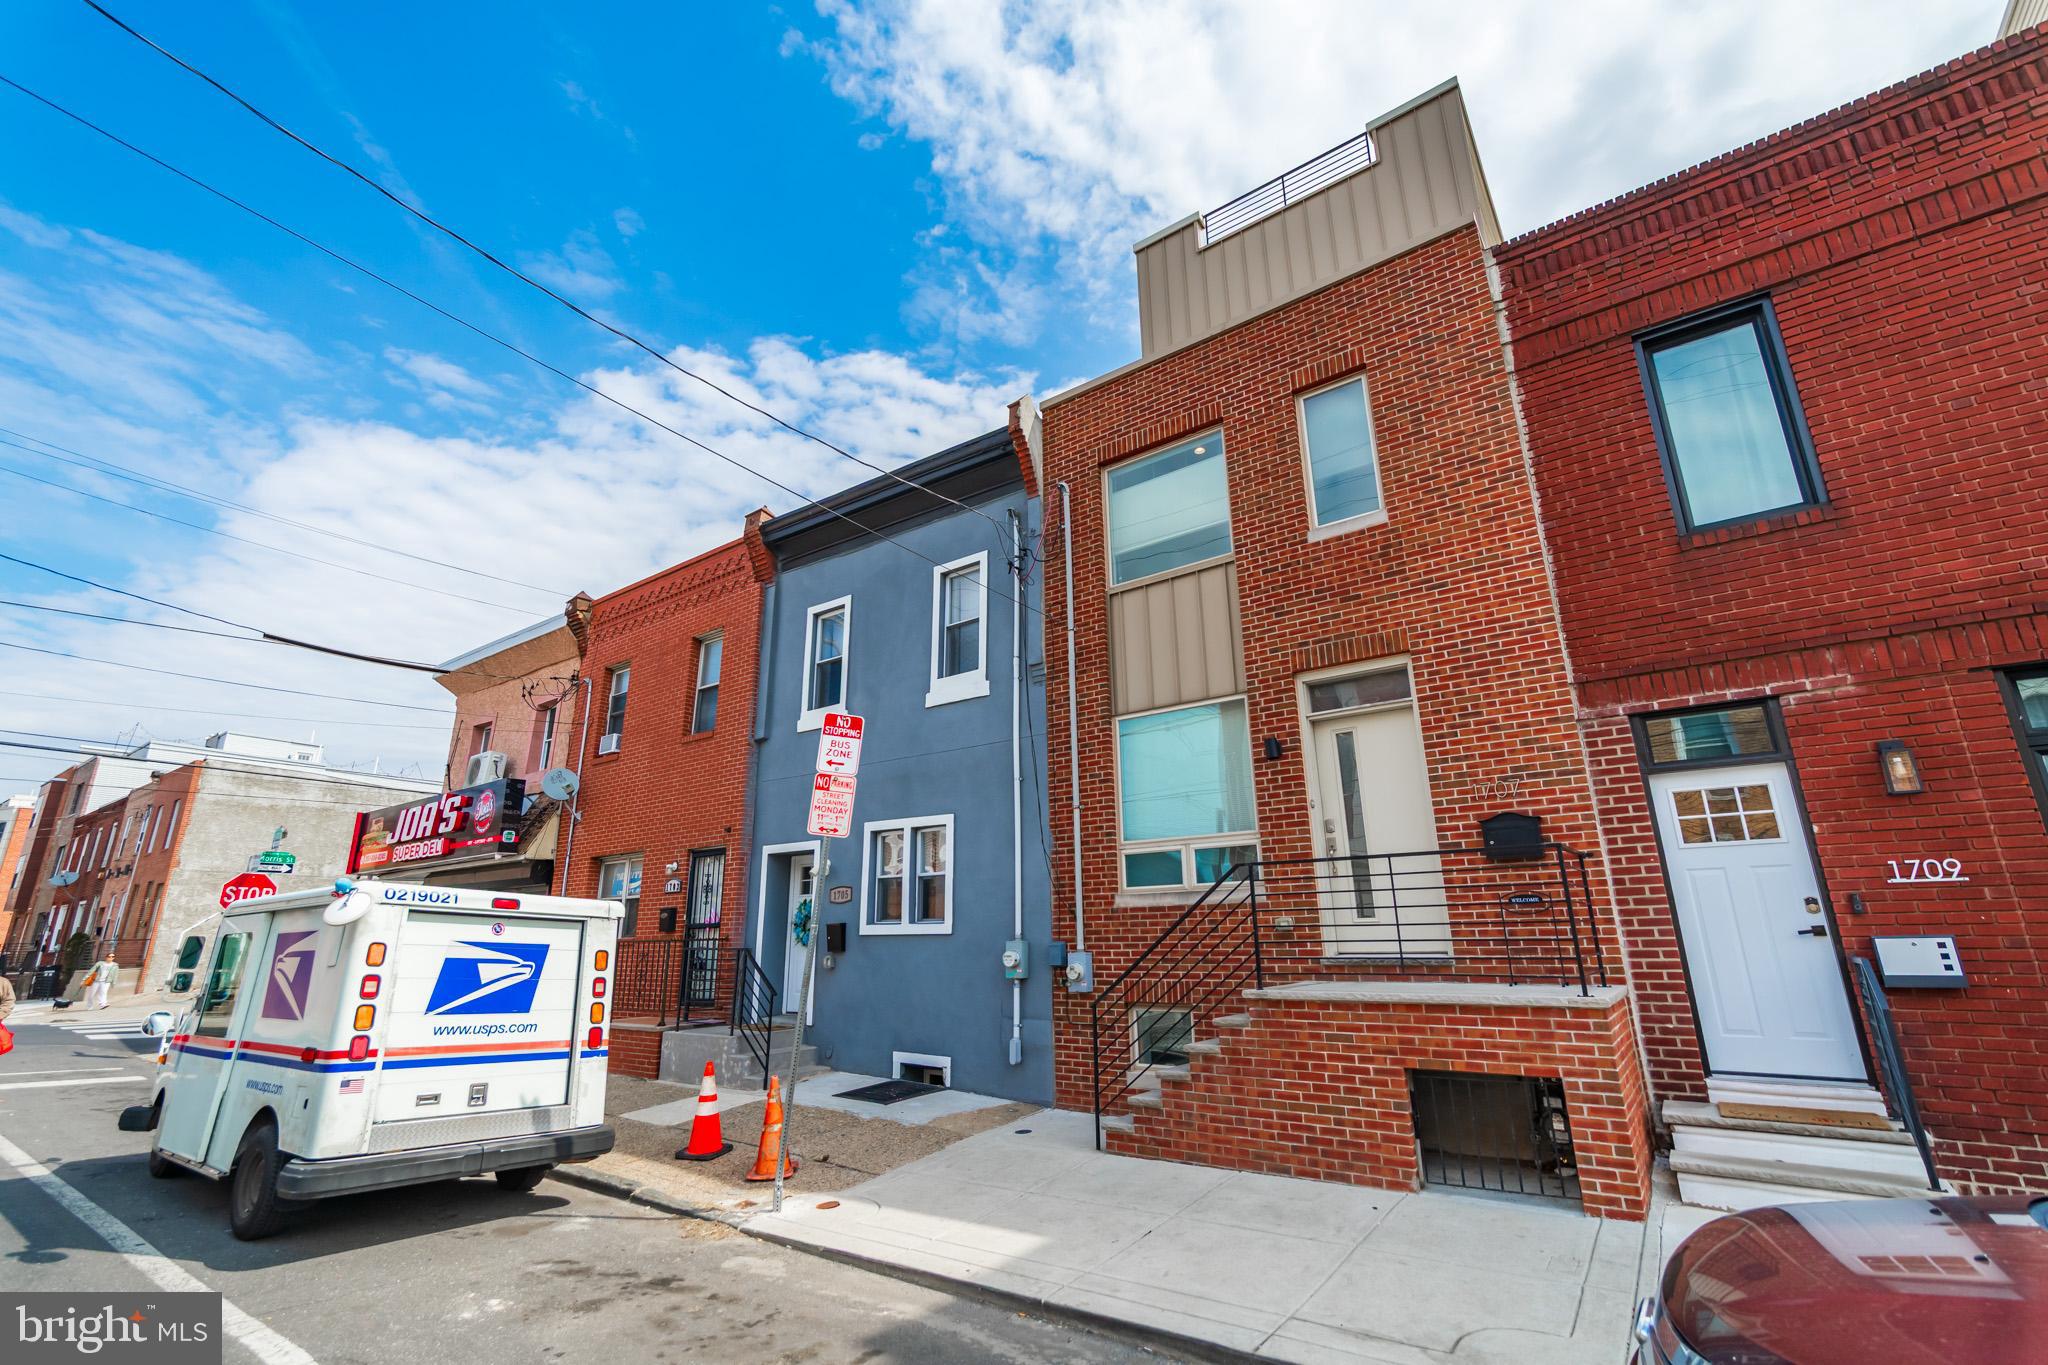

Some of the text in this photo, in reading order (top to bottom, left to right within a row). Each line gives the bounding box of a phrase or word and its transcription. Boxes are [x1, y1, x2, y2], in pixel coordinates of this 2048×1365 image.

[836, 716, 851, 728] NO
[825, 726, 861, 738] STOPPING
[830, 739, 851, 749] BUS
[826, 748, 852, 759] ZONE
[816, 776, 829, 788] NO
[1472, 779, 1520, 800] 1707
[816, 797, 848, 807] CLEANING
[814, 805, 849, 815] MONDAY
[386, 794, 462, 844] JOA'S
[392, 842, 422, 863] SUPER
[422, 837, 445, 858] DELI
[1887, 858, 1962, 880] 1709
[223, 885, 274, 903] STOP
[384, 888, 460, 905] 0219021
[433, 1022, 538, 1037] www.usps.com
[246, 1079, 284, 1096] www.usps.com
